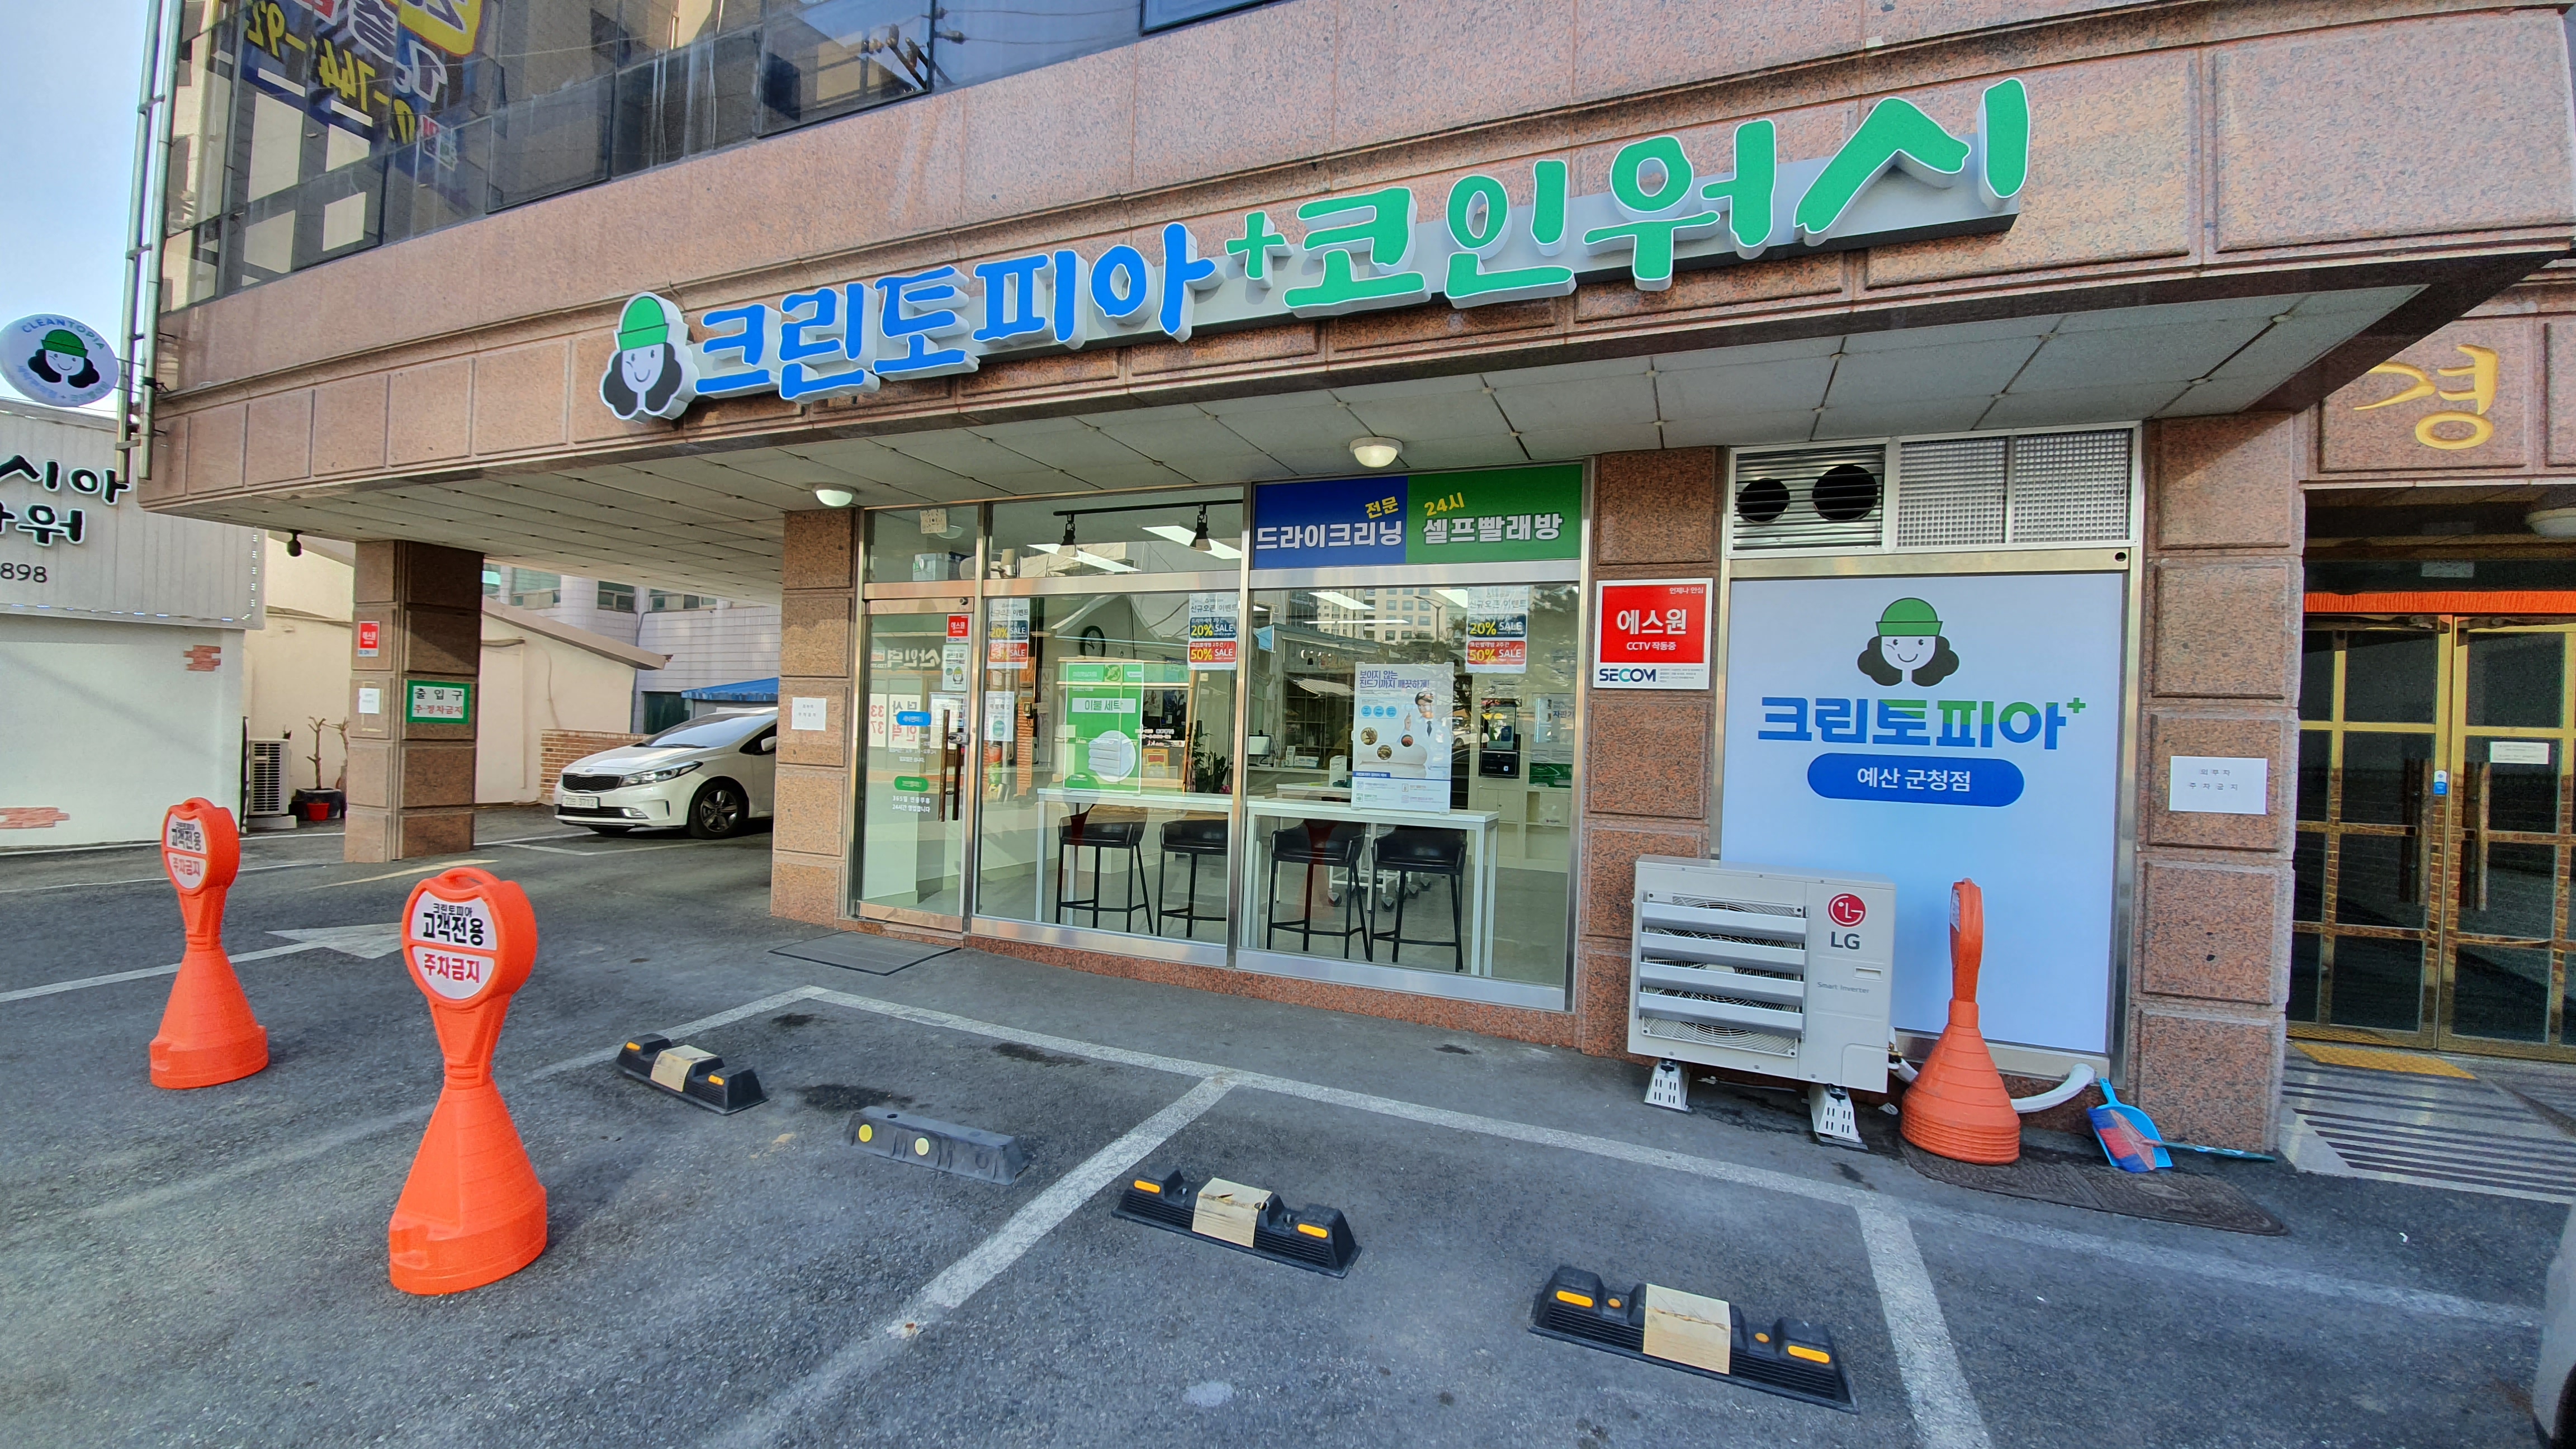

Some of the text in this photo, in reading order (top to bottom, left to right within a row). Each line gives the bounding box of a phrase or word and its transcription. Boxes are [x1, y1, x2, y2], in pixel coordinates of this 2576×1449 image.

[694, 223, 1218, 400] 크린토피아
[1282, 78, 2030, 309] 코인워시
[21, 318, 106, 351] CLEANTOPIA
[1365, 492, 1465, 519] 전문 24시
[1255, 513, 1564, 550] 드라이크리닝 셀프빨래방
[1012, 608, 1029, 617] 이벤트
[1190, 604, 1238, 613] 신규오픈 이벤트
[1469, 621, 1523, 636] 20% SALE
[1617, 609, 1687, 635] 에스원
[991, 627, 1009, 638] 20%
[1191, 624, 1234, 637] 20% SALE
[1626, 641, 1677, 651] CCTV 작동중
[1190, 648, 1213, 661] 50%
[1469, 648, 1522, 662] 50% SALE
[1359, 670, 1399, 680] 보이지 않는
[1599, 668, 1657, 683] SECOM
[1359, 679, 1430, 689] 진드기까지 깨끗하게!
[414, 688, 463, 702] 출입구
[1084, 700, 1102, 711] 이불
[1856, 766, 1972, 793] 예산 군청점
[171, 828, 201, 851] 고객전용
[173, 857, 201, 877] 주차금지
[433, 902, 473, 918] 크린토피아
[423, 912, 485, 946] 고객전용
[1830, 931, 1860, 950] LG
[424, 953, 480, 984] 주차금지
[1817, 982, 1870, 993] Smart Inverter
